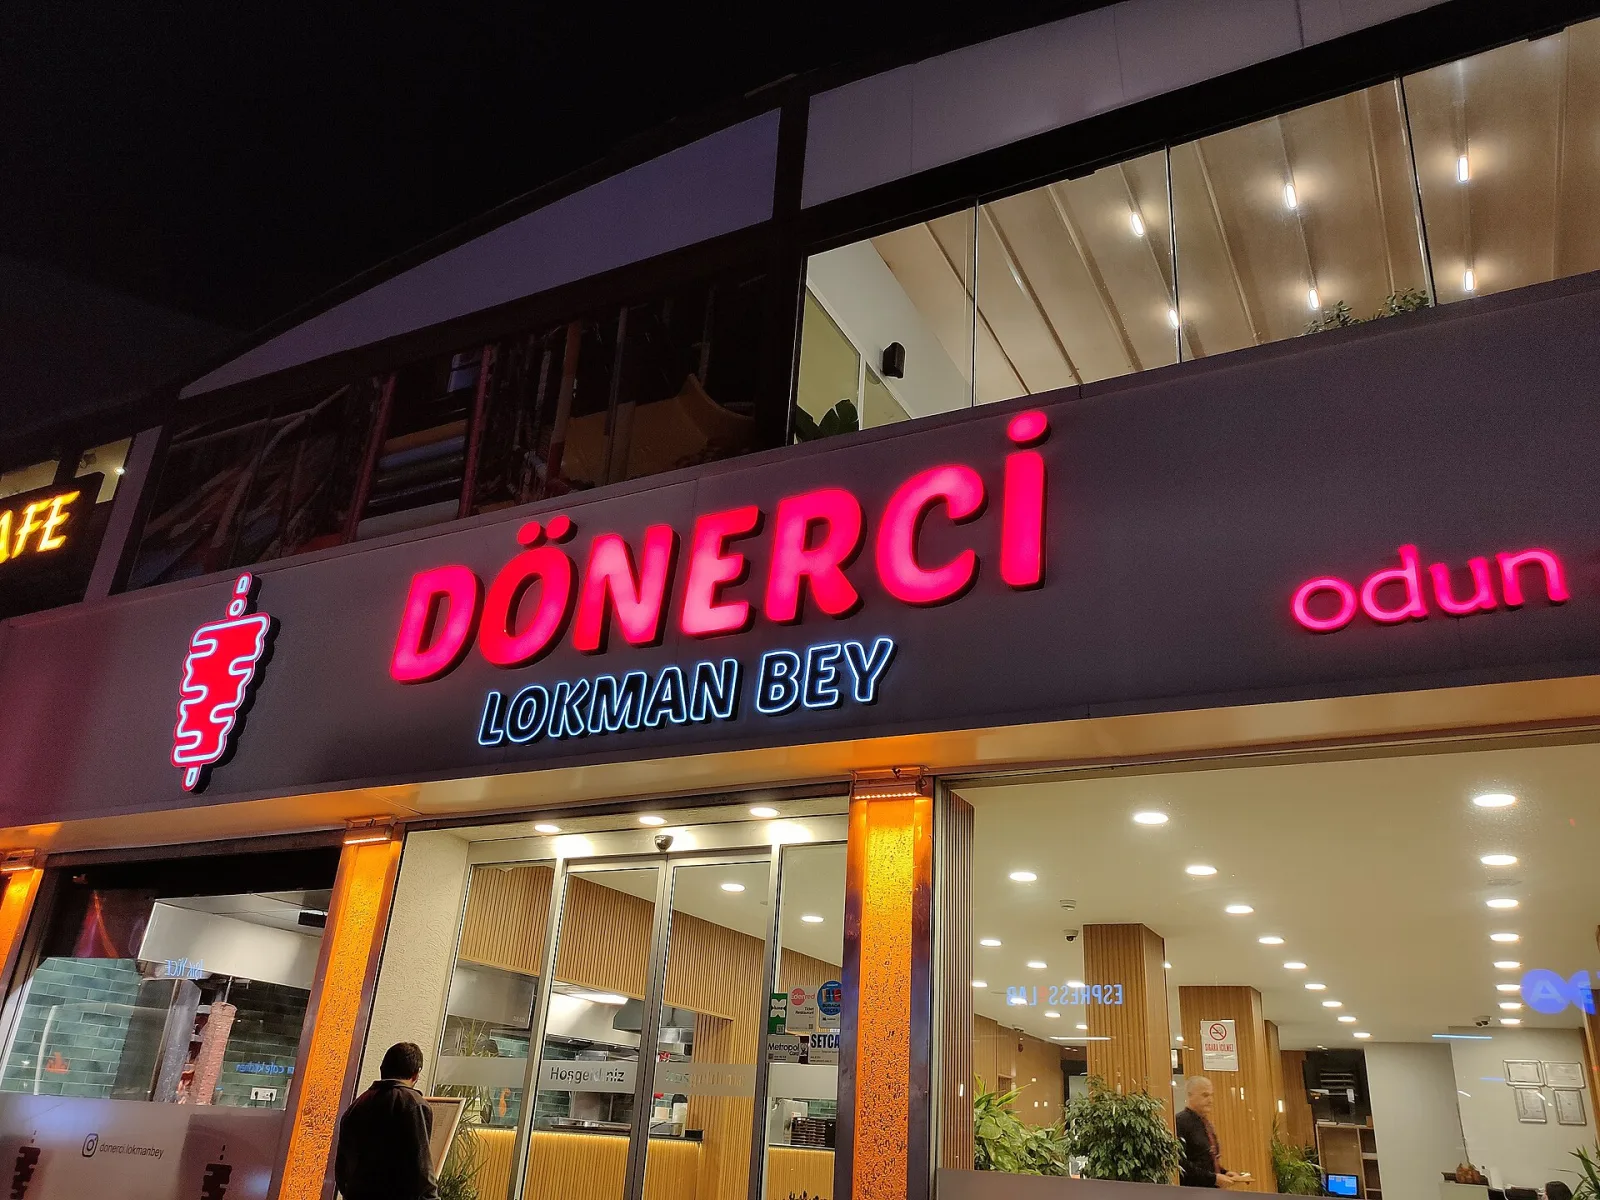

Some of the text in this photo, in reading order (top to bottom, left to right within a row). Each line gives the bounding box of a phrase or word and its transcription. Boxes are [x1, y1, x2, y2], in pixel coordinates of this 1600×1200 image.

[389, 411, 1049, 684] DÖNERCİ
[1291, 543, 1571, 632] odun
[477, 636, 896, 747] LOKMAN BEY
[550, 1066, 625, 1084] Hoşgeldniz
[768, 1042, 799, 1053] Metropol
